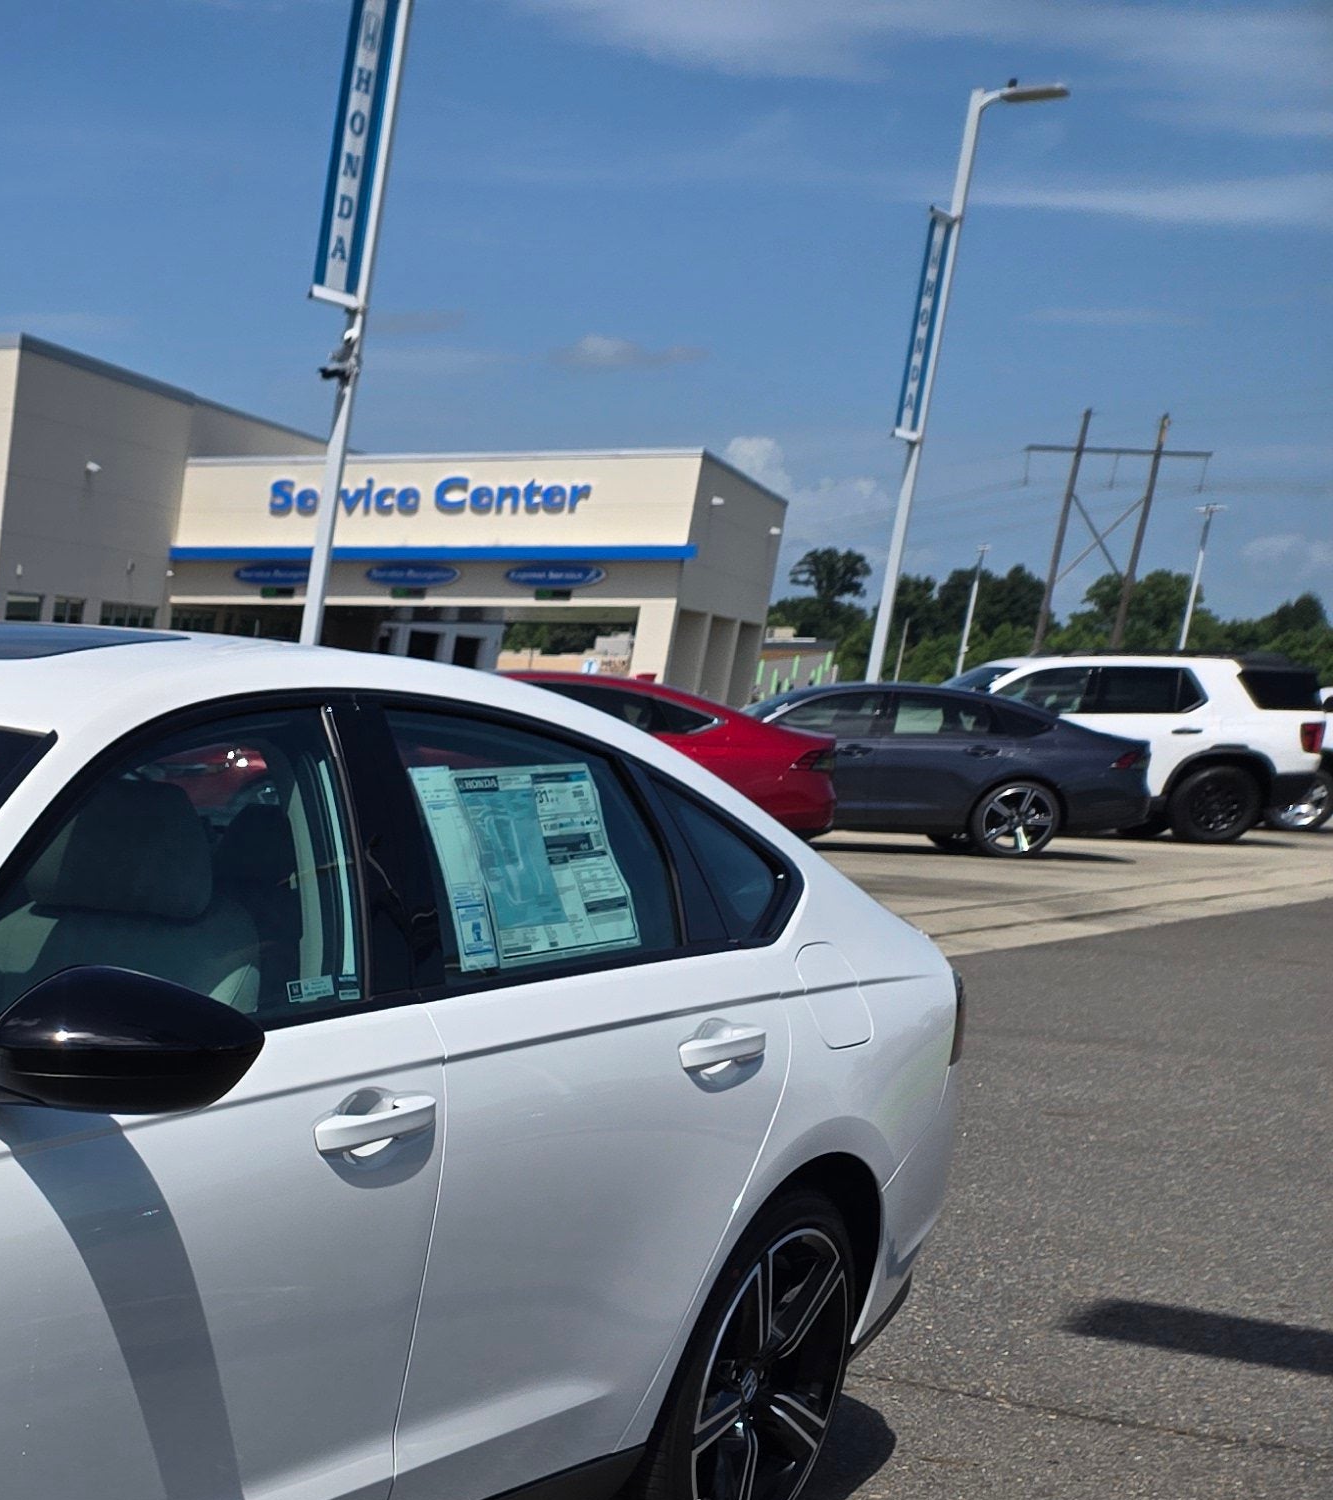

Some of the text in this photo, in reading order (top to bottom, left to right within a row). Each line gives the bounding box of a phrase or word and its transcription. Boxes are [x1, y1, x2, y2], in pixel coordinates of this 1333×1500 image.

[330, 67, 372, 262] HONDA
[903, 283, 935, 411] HONDA
[268, 476, 593, 516] Sevice Center
[464, 778, 498, 790] HONDA
